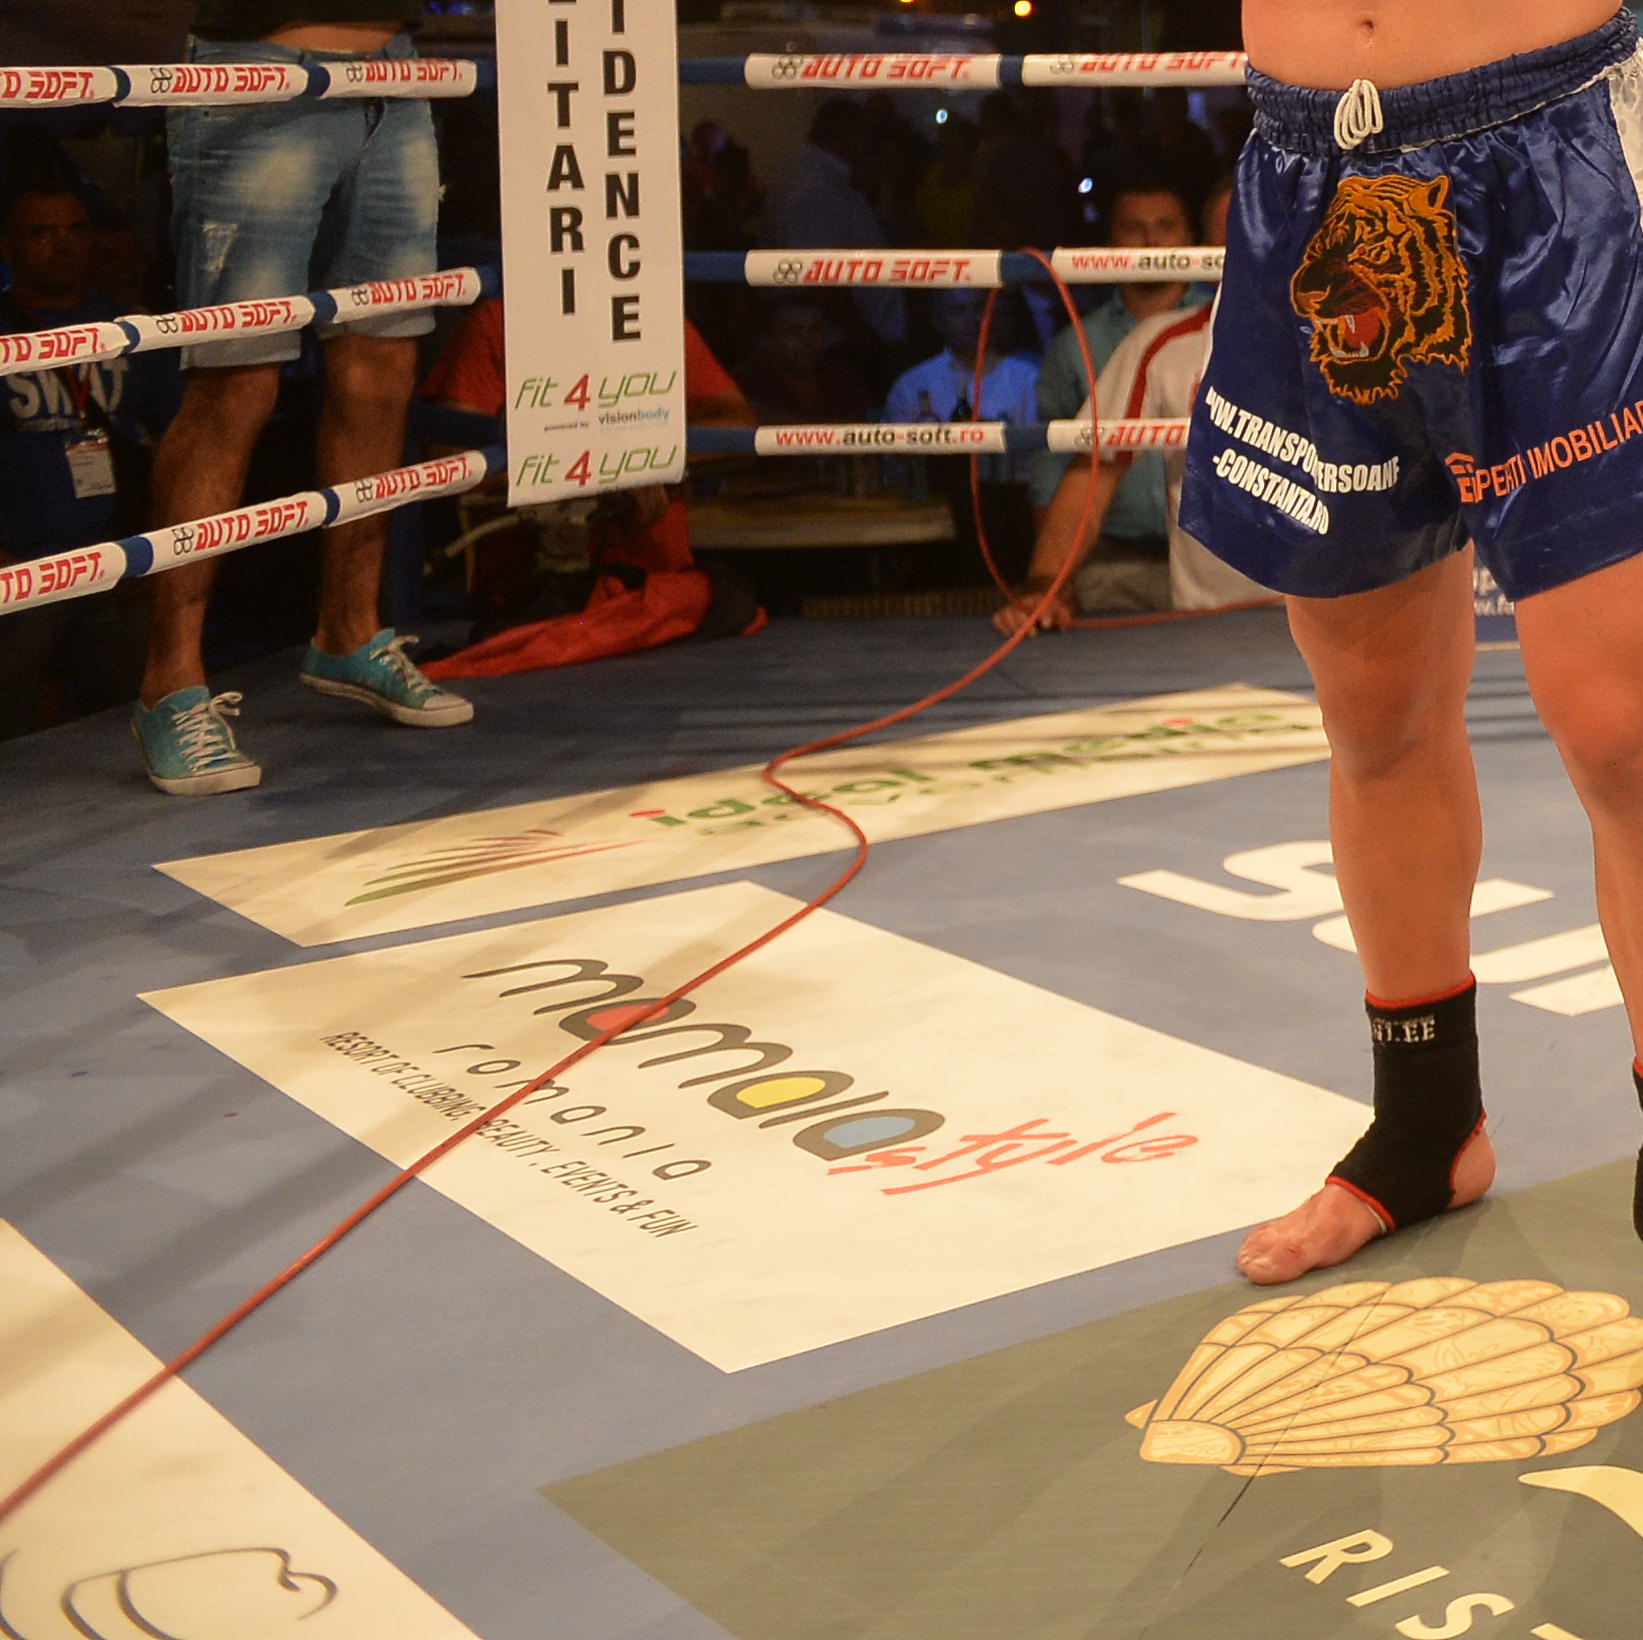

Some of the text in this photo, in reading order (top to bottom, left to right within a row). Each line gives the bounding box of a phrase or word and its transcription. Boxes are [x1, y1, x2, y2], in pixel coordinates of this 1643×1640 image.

[172, 66, 231, 94] AUTO
[802, 56, 883, 79] AUTO
[803, 260, 881, 283] AUTO
[1072, 250, 1226, 272] www.auto-so
[0, 335, 31, 362] TO
[514, 370, 678, 411] fit 4 you
[515, 444, 678, 487] fit 4 you
[0, 570, 32, 604] TO
[320, 1031, 400, 1068] RESORT
[539, 1159, 626, 1208] EVENTS
[627, 1208, 699, 1239] FUN
[1279, 1528, 1586, 1640] RIS
